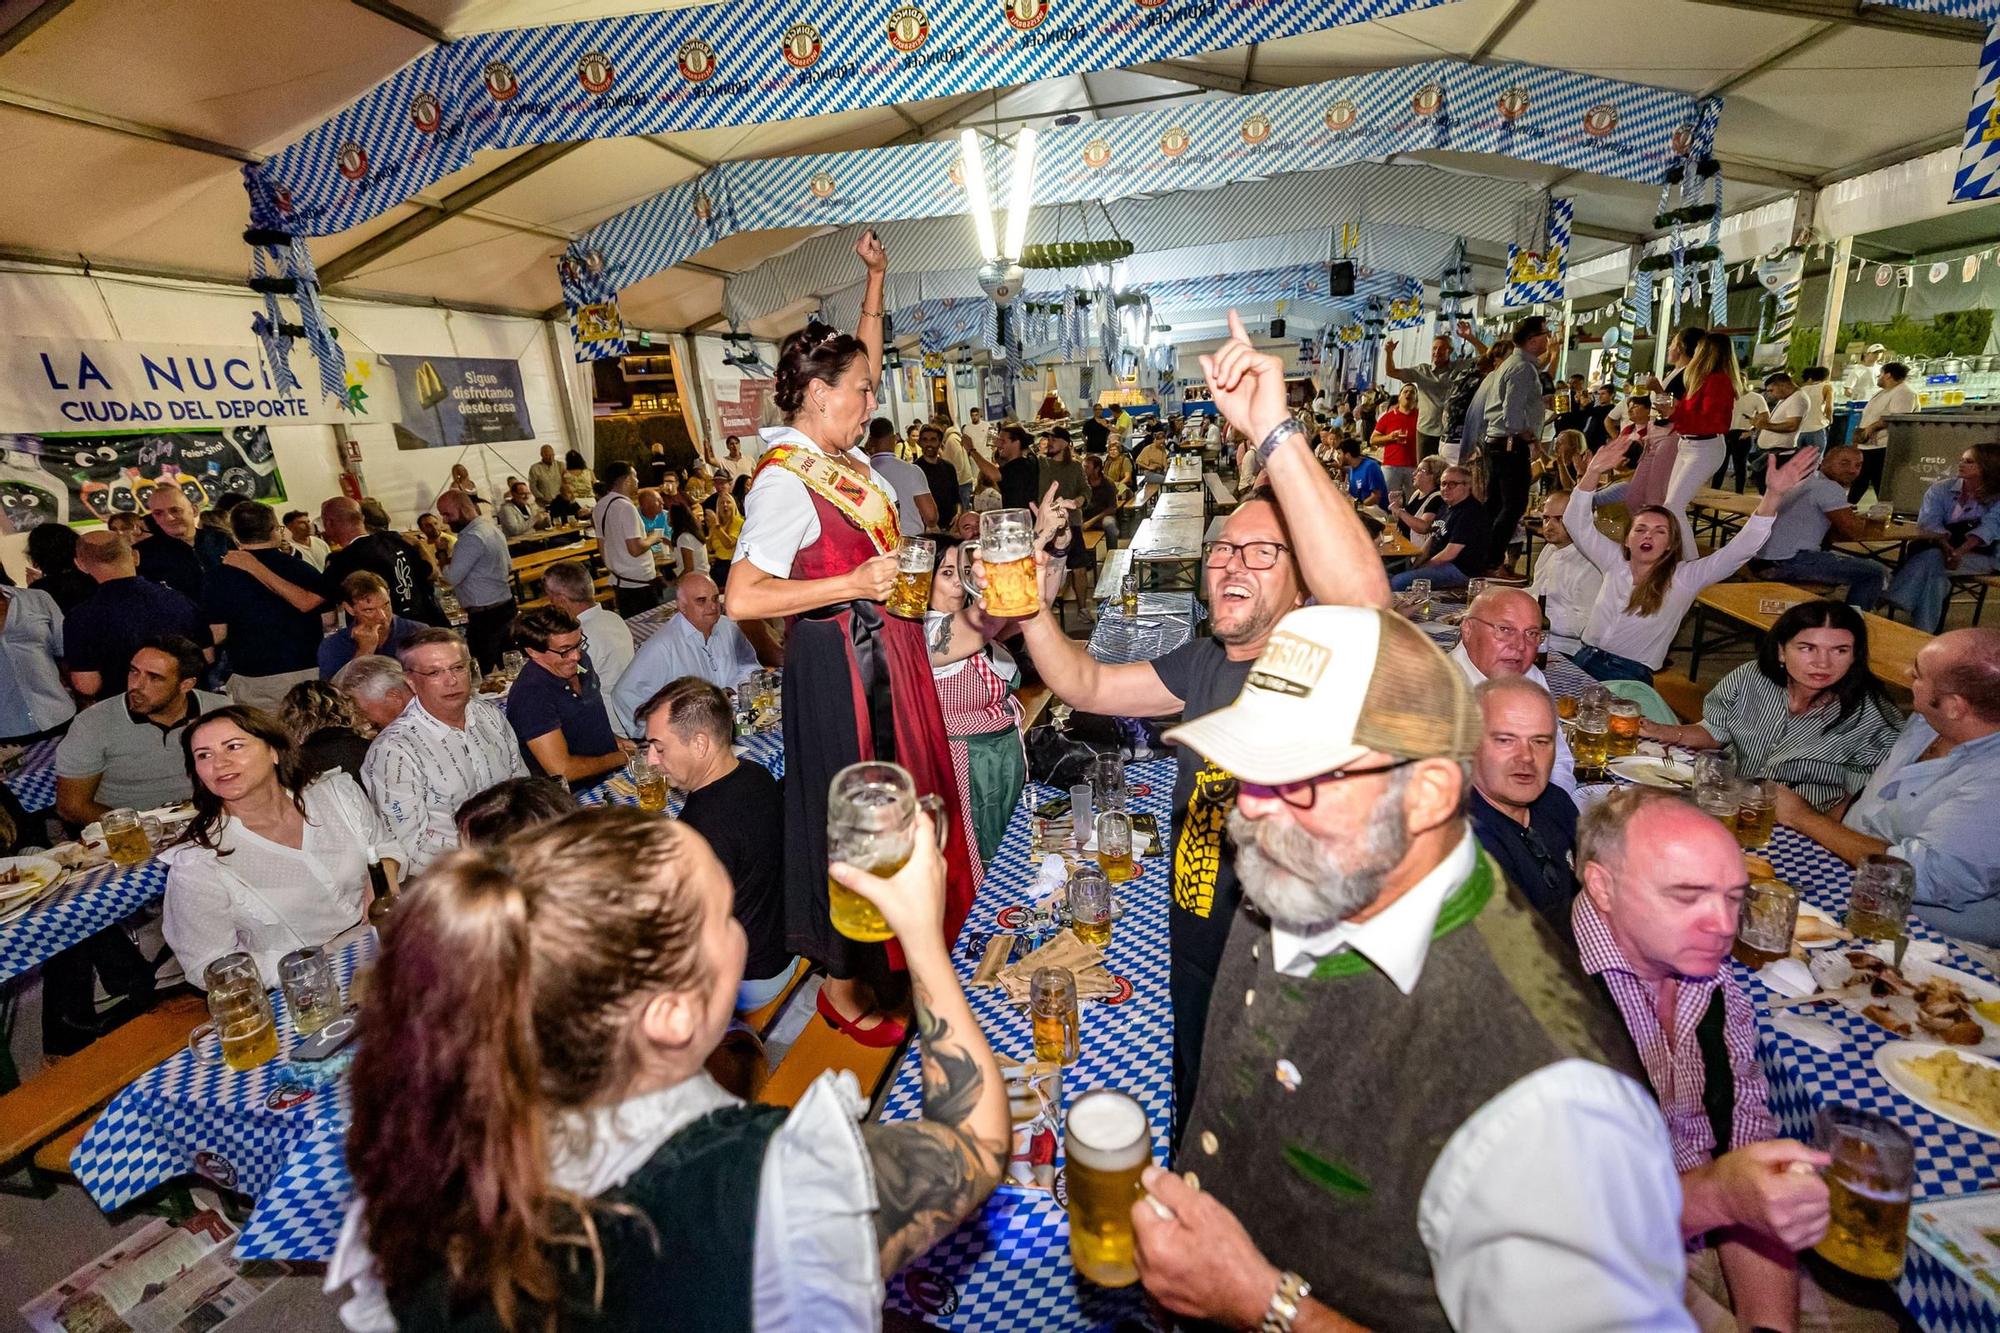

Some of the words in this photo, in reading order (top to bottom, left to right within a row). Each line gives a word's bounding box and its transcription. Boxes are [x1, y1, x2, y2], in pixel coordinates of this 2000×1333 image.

[40, 351, 112, 390] LA
[465, 371, 498, 386] Sigue
[452, 385, 514, 400] disfrutando
[61, 400, 163, 422] CIUDAD
[168, 400, 214, 420] DEL
[216, 399, 308, 419] DEPORTE
[458, 402, 492, 414] desde
[493, 402, 516, 413] casa
[1920, 456, 1946, 464] resto
